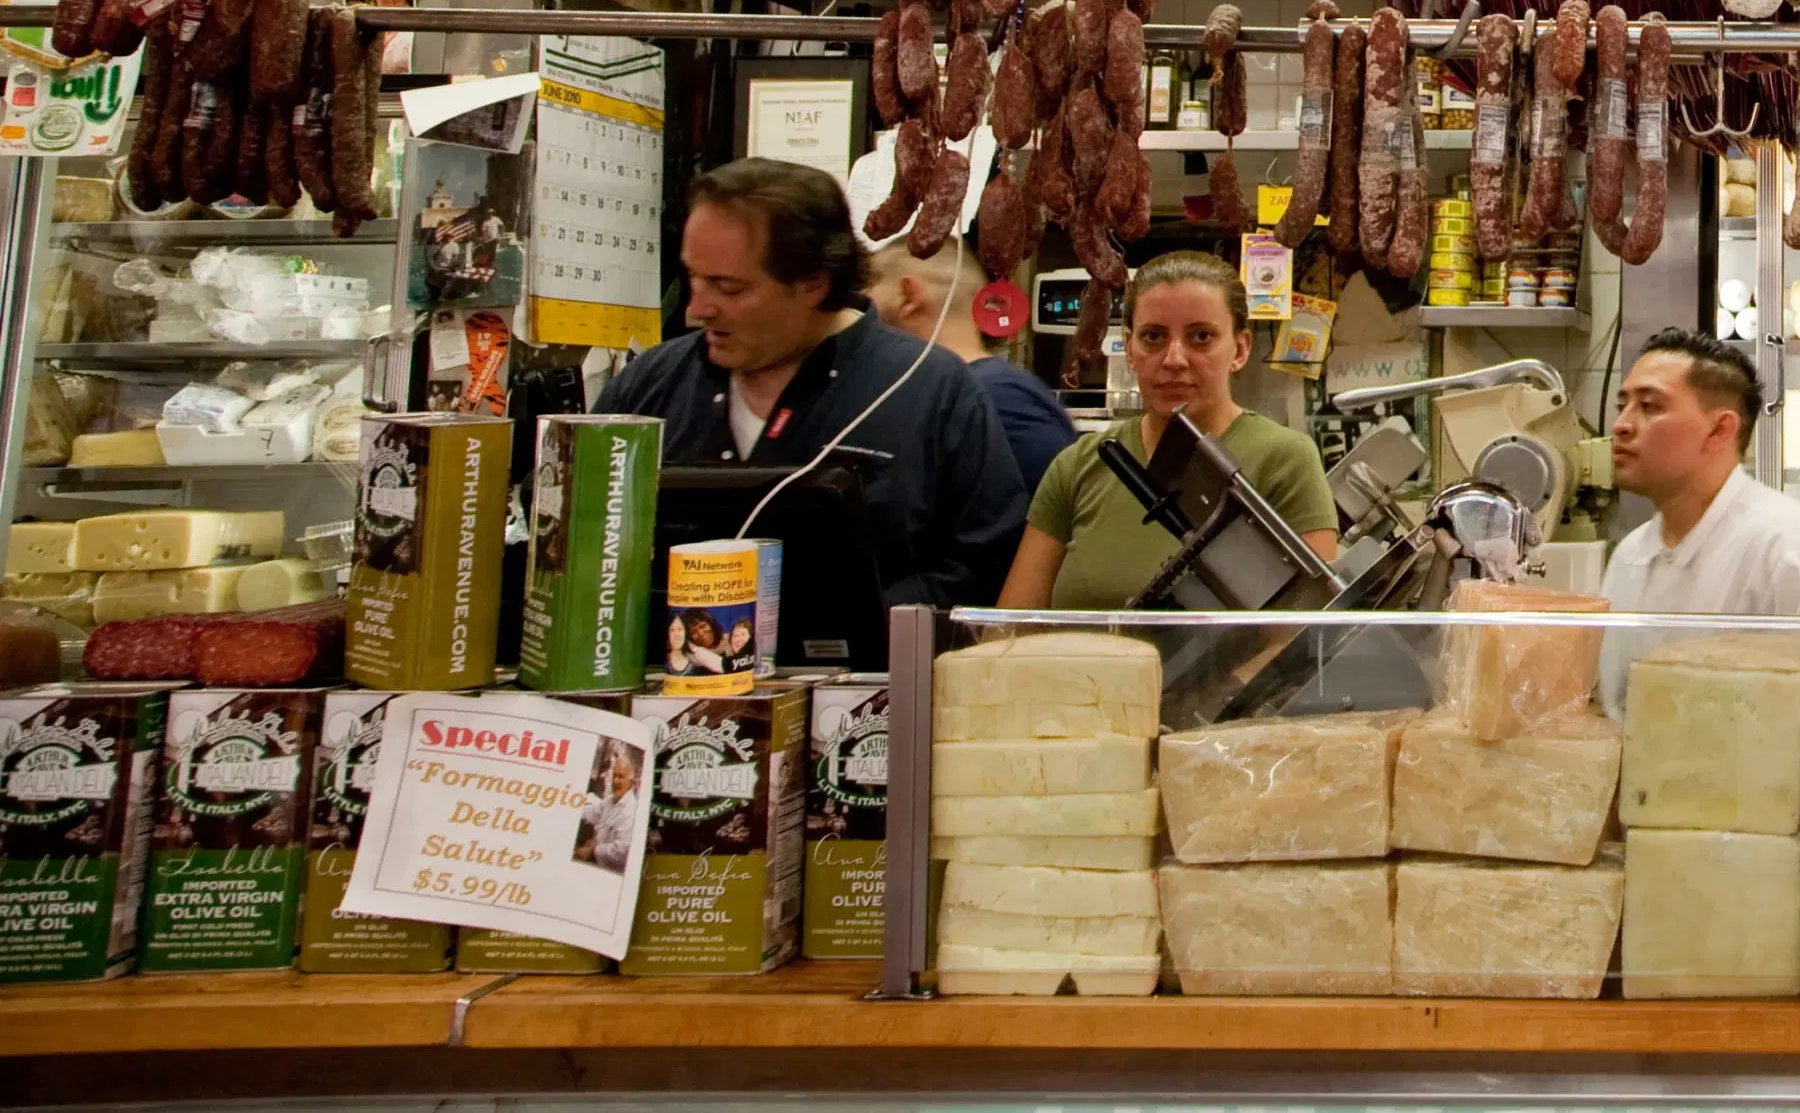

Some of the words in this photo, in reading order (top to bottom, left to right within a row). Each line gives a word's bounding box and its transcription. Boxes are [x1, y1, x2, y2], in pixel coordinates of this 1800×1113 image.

[542, 83, 562, 99] JUNE
[563, 88, 581, 105] 2010
[785, 110, 822, 125] NIAF
[449, 436, 483, 675] ARTHURAVENUE.COM
[593, 435, 628, 678] ARTHURAVENUE.COM
[682, 559, 701, 571] YAI
[702, 559, 744, 571] Network
[671, 581, 711, 592] Creating
[713, 579, 743, 591] HOPE
[692, 593, 714, 603] with
[364, 608, 390, 625] PURE
[353, 620, 379, 636] OLIVE
[379, 626, 396, 640] OIL
[213, 742, 255, 758] ARTHUR
[419, 719, 572, 766] Special
[26, 750, 70, 767] ARTHUR
[674, 749, 715, 768] ARTHUR
[15, 771, 70, 794] ITALIAN
[73, 768, 108, 794] DELI
[204, 764, 255, 785] ITALIAN
[664, 770, 718, 792] ITALIAN
[722, 768, 752, 792] DELI
[166, 786, 204, 814] LITTLE
[204, 803, 244, 815] ITALY,
[244, 792, 272, 810] NYC
[324, 785, 361, 814] LITTLE
[817, 778, 857, 805] LITTLE
[17, 812, 56, 825] ITALY,
[58, 799, 88, 818] NYC
[447, 800, 532, 835] Della
[671, 809, 708, 821] ITALY,
[709, 798, 734, 816] NYC
[157, 841, 287, 877] Isabella
[0, 853, 100, 888] sabella
[182, 879, 258, 892] IMPORTED
[412, 866, 533, 907] $5.99/lb
[656, 885, 726, 897] IMPORTED
[154, 892, 214, 906] EXTRA
[218, 890, 285, 905] VIRGIN
[666, 897, 716, 910] PURE
[831, 895, 883, 908] OLIVE
[28, 900, 99, 917] VIRGIN
[169, 906, 227, 920] OLIVE
[229, 905, 264, 919] OIL
[647, 911, 701, 924] OLIVE
[702, 910, 733, 924] OIL
[38, 917, 74, 932] OIL
